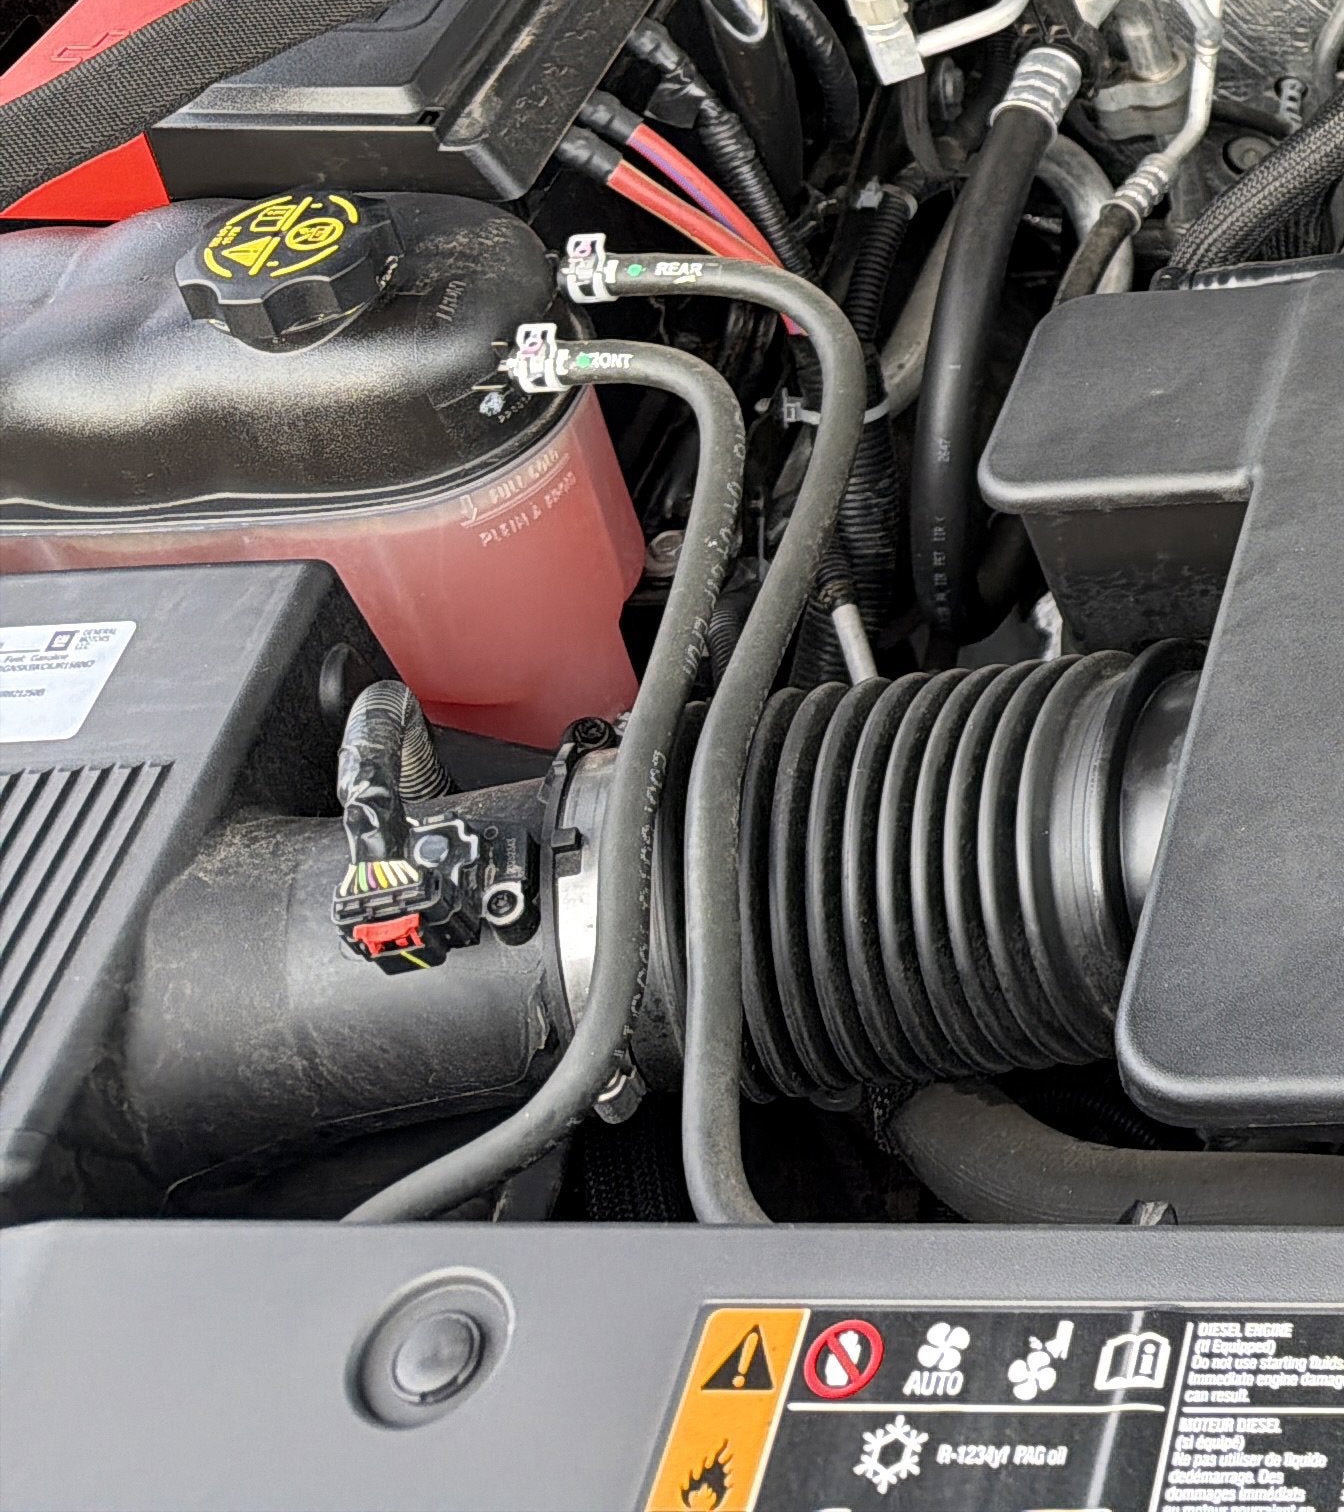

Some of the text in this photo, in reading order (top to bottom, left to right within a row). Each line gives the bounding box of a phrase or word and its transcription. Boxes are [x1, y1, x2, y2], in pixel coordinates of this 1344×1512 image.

[655, 262, 703, 276] REAR
[1197, 1322, 1294, 1338] DIESEL ENGINE
[1211, 1339, 1276, 1356] Equipped)
[1191, 1355, 1210, 1369] Do
[1211, 1356, 1233, 1369] not
[1234, 1358, 1257, 1370] use
[1259, 1356, 1308, 1372] starting
[903, 1370, 964, 1396] AUTO
[1255, 1372, 1299, 1390] engine
[1184, 1389, 1209, 1403] can
[1178, 1417, 1282, 1433] MOTEUR DIESEL
[1013, 1445, 1047, 1465] PAG
[1046, 1446, 1068, 1466] oil
[1171, 1452, 1328, 1470] Ne pas utiliser de liquide
[1257, 1469, 1284, 1485] Des
[1164, 1486, 1236, 1504] dommages
